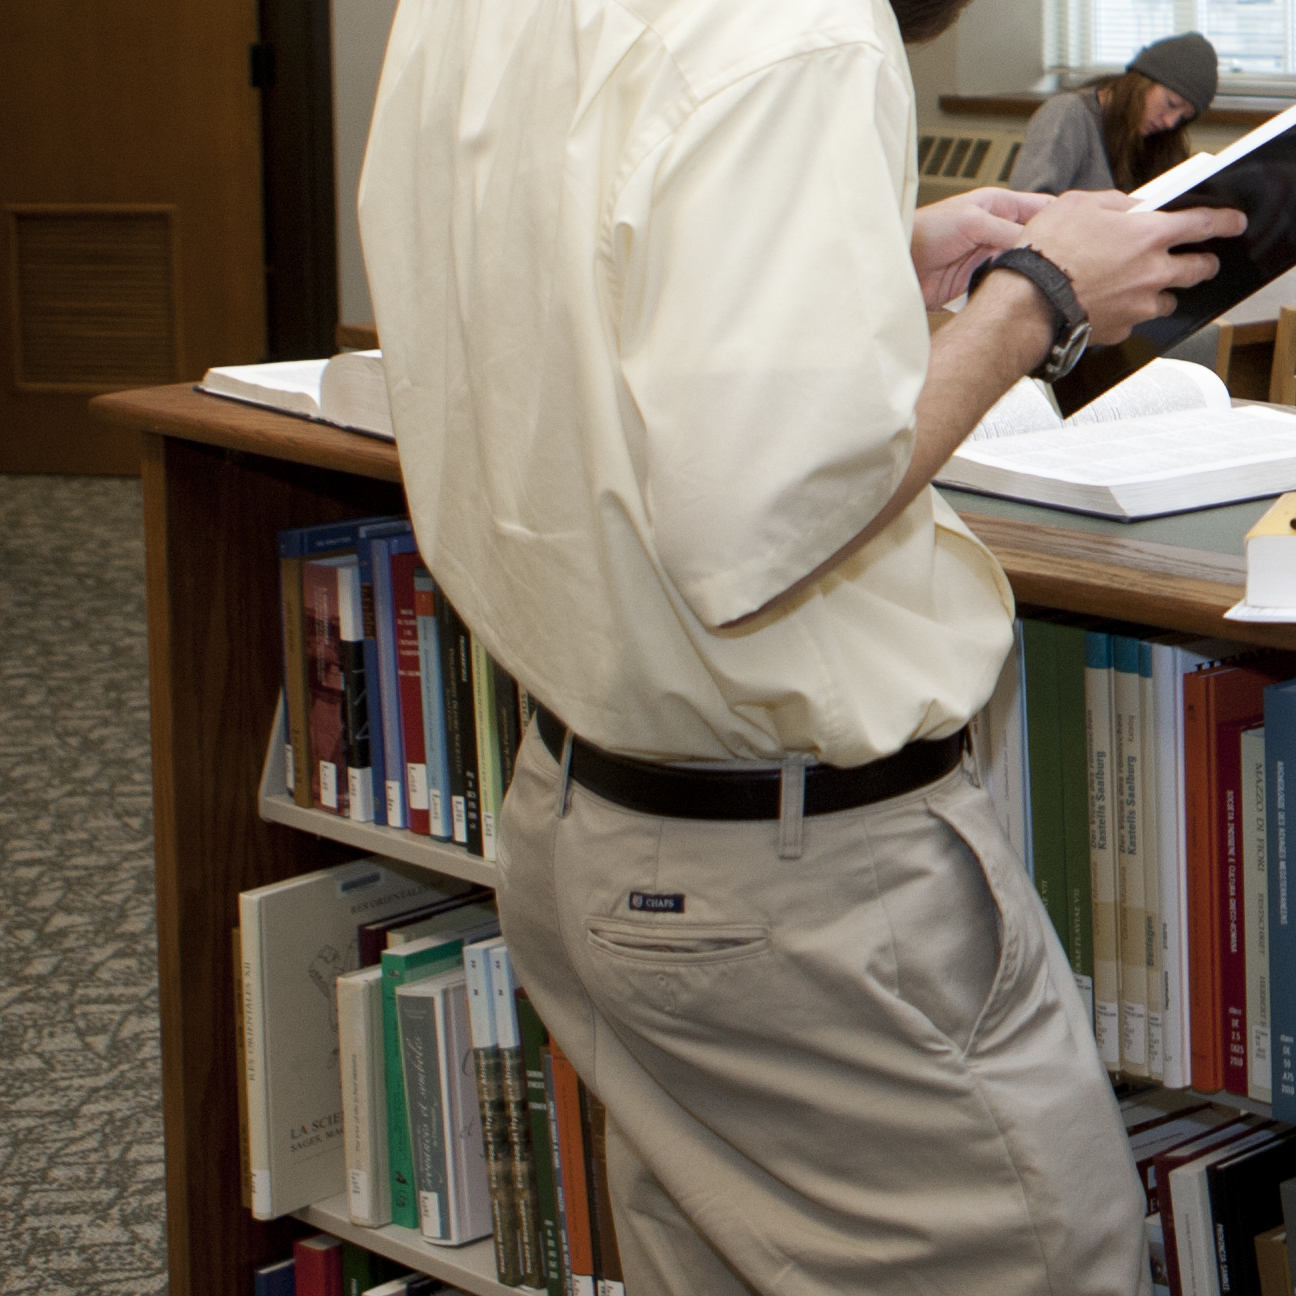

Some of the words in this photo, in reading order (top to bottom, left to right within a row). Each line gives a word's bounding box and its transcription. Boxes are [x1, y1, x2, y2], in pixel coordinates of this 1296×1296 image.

[1093, 749, 1107, 802] Saalburg
[1124, 753, 1137, 807] Saalburg
[1253, 761, 1265, 813] MAZZO
[1094, 803, 1107, 850] Kastells
[1125, 809, 1137, 855] Kastells
[1254, 815, 1265, 832] DI
[1255, 836, 1266, 873] FIORI
[645, 898, 675, 909] CHAPS
[308, 1110, 345, 1135] SCIE
